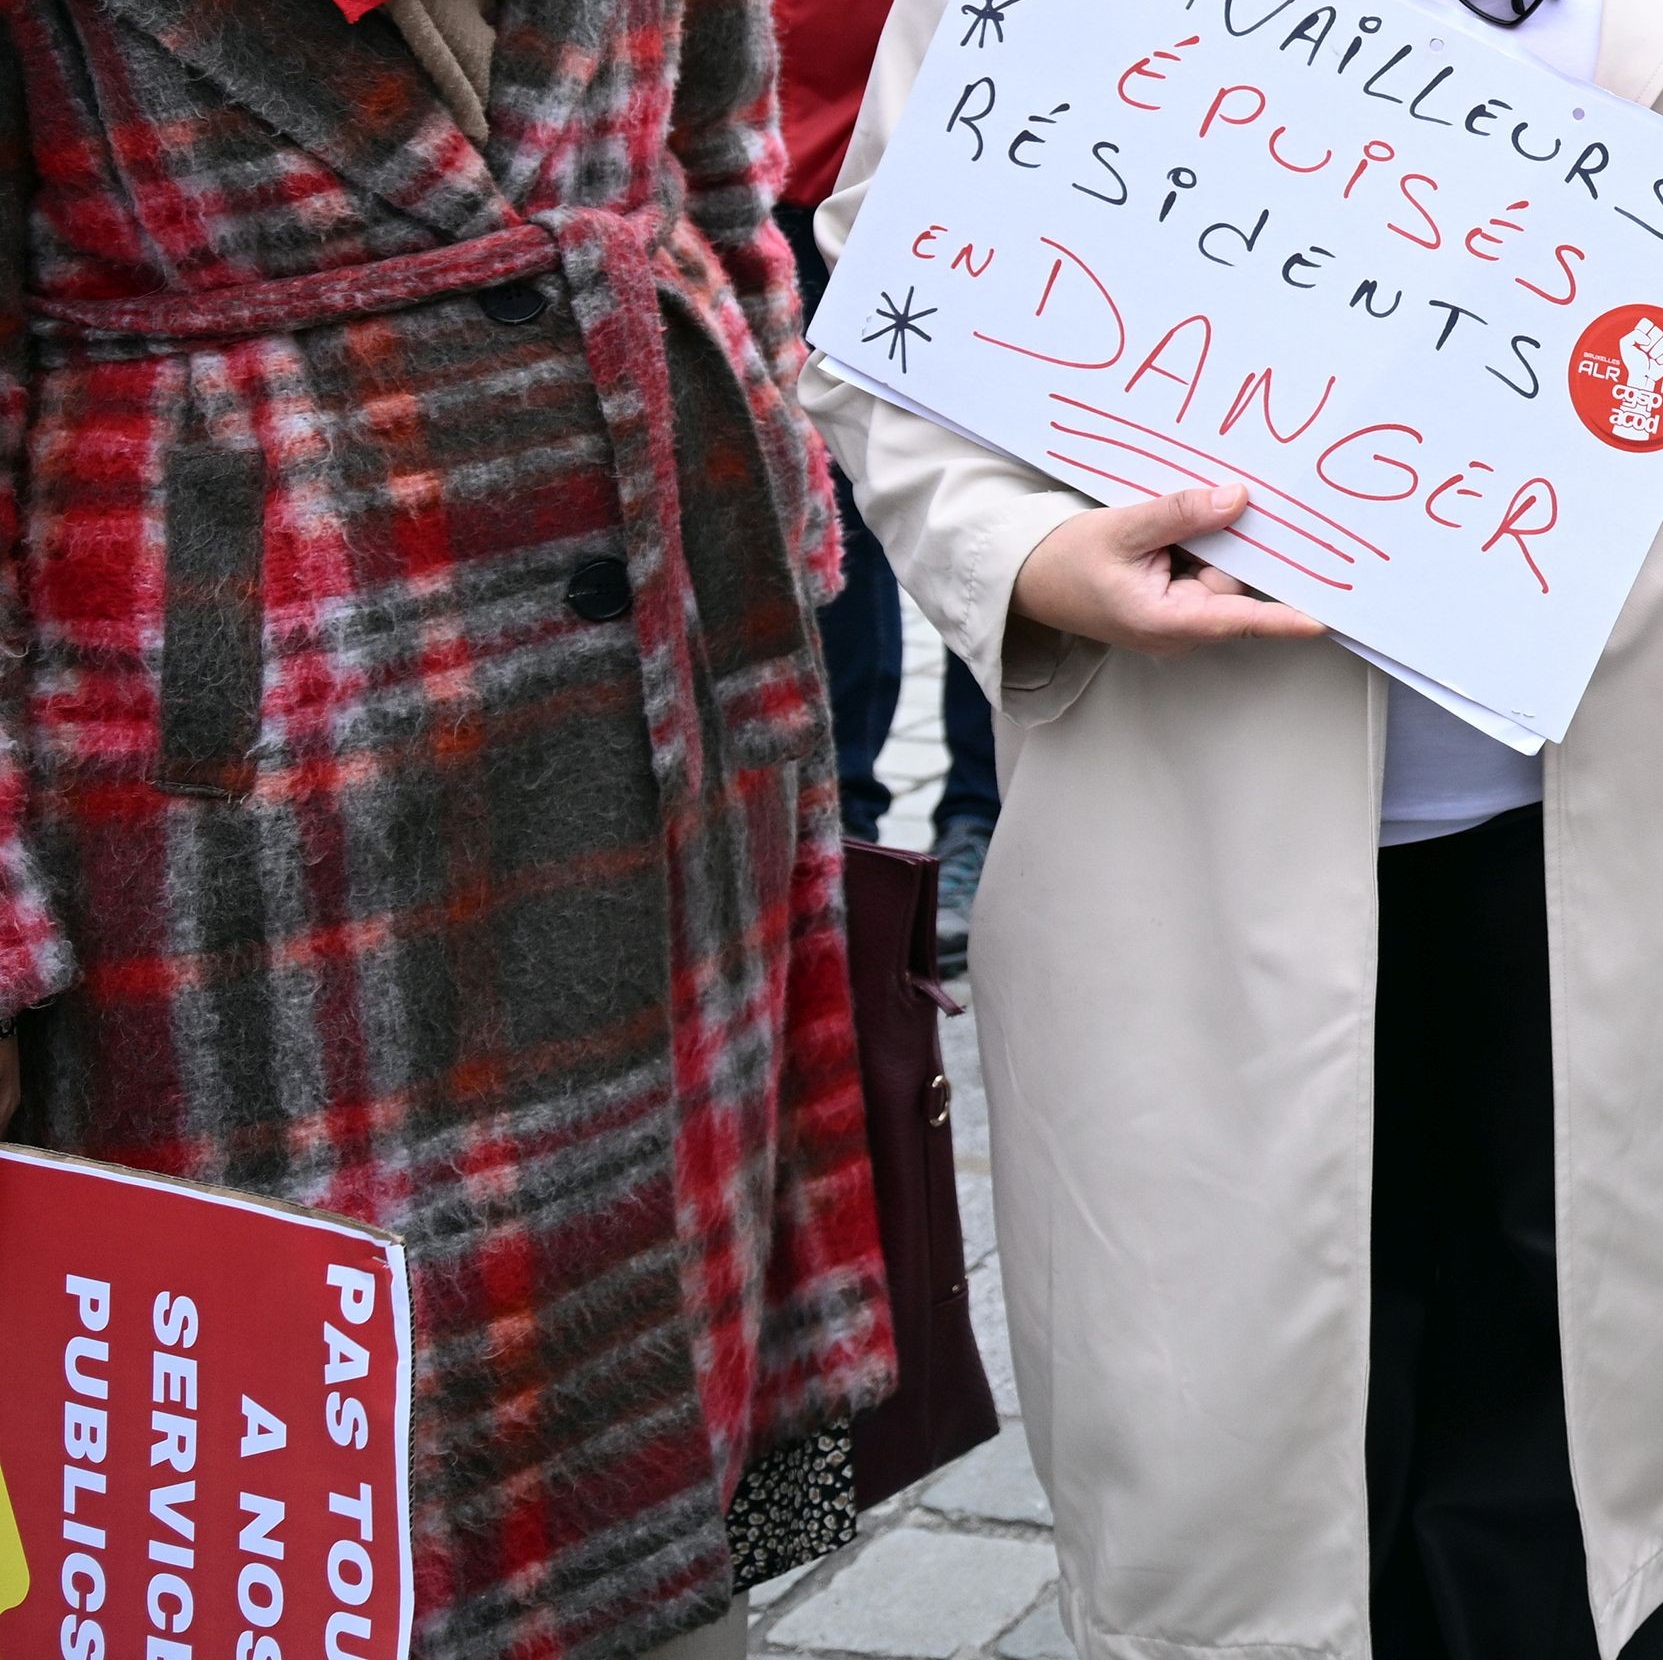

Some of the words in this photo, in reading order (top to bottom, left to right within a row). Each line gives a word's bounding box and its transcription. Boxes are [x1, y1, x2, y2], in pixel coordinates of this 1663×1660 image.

[1578, 360, 1621, 382] ALR
[1583, 351, 1621, 366] BRUXELLES
[912, 225, 994, 277] EN
[973, 237, 1559, 594] DANGER
[1611, 384, 1663, 413] cgsp
[1609, 408, 1661, 434] acod
[323, 1263, 376, 1451] PAS
[240, 1393, 287, 1458] A
